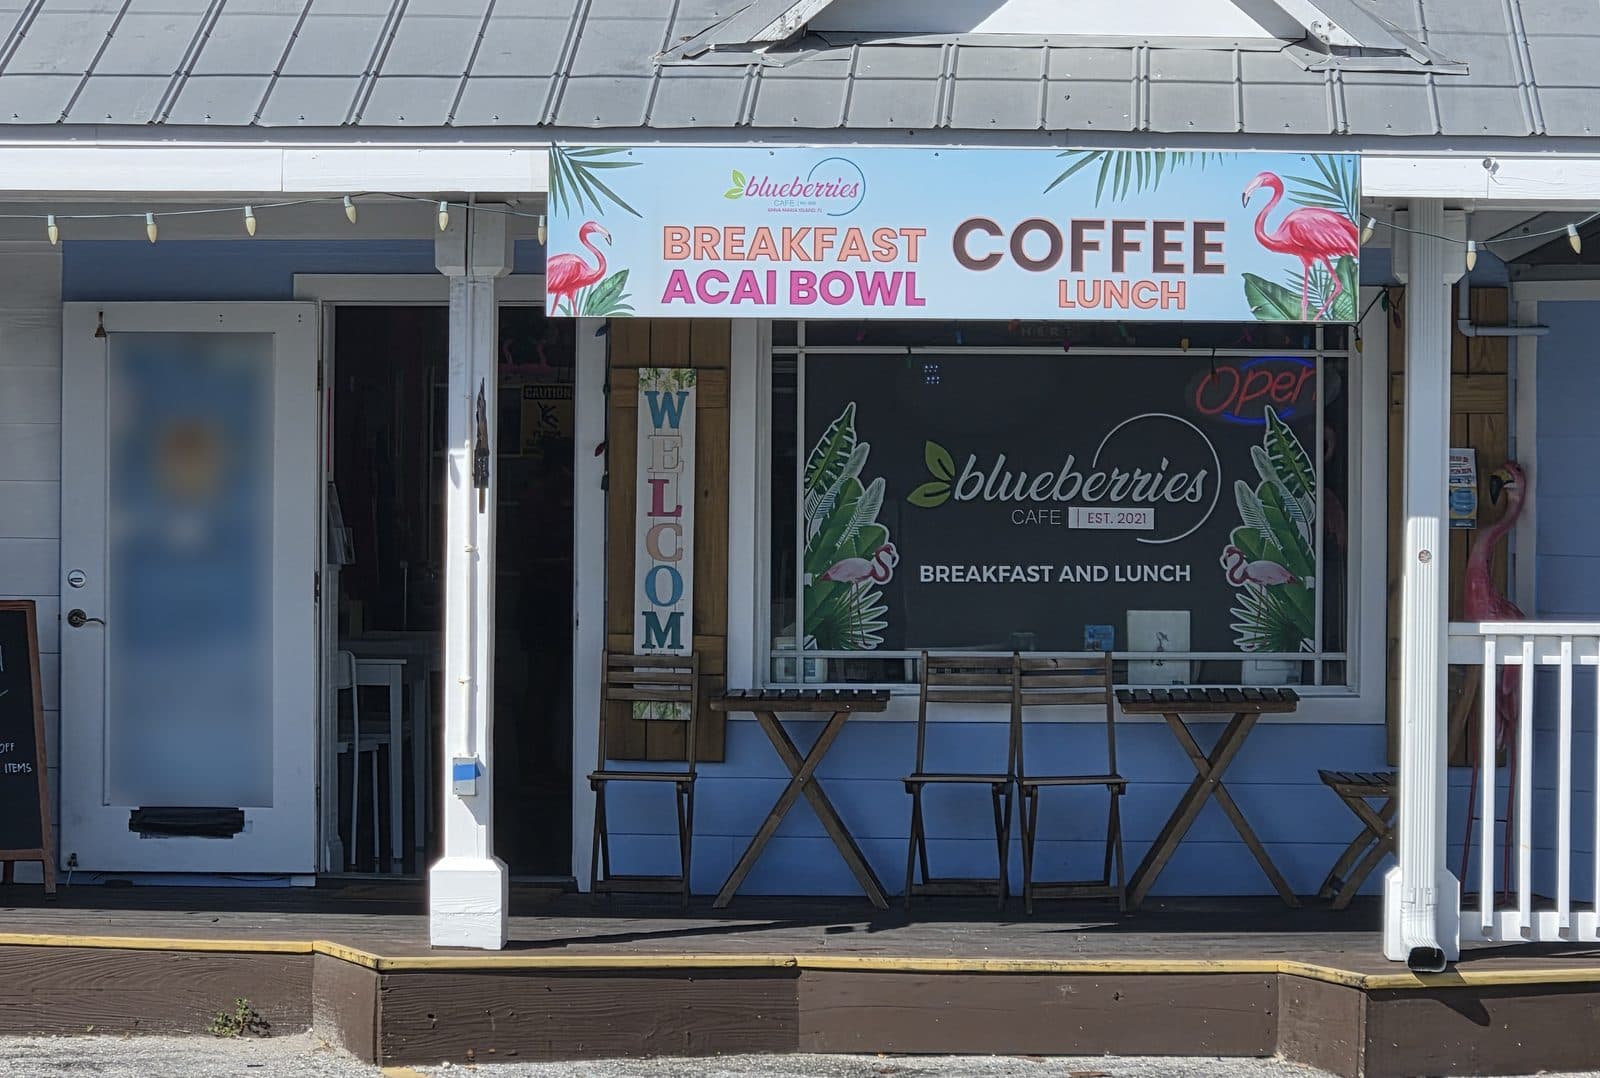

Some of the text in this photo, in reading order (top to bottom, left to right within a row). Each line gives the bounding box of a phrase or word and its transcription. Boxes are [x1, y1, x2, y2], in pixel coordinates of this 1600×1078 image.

[744, 176, 860, 198] blueberries
[663, 226, 927, 263] BREAKFAST
[952, 216, 1226, 274] COFFEE
[661, 269, 926, 306] ACAI BOWL
[1058, 280, 1186, 310] LUNCH
[526, 386, 571, 398] CAUTION
[954, 454, 1208, 502] blueberries
[640, 391, 690, 656] WELCOM
[1011, 509, 1147, 525] CAFE EST. 2021
[919, 564, 1191, 583] BREAKFAST AND LUNCH
[4, 762, 32, 773] ITEMS
